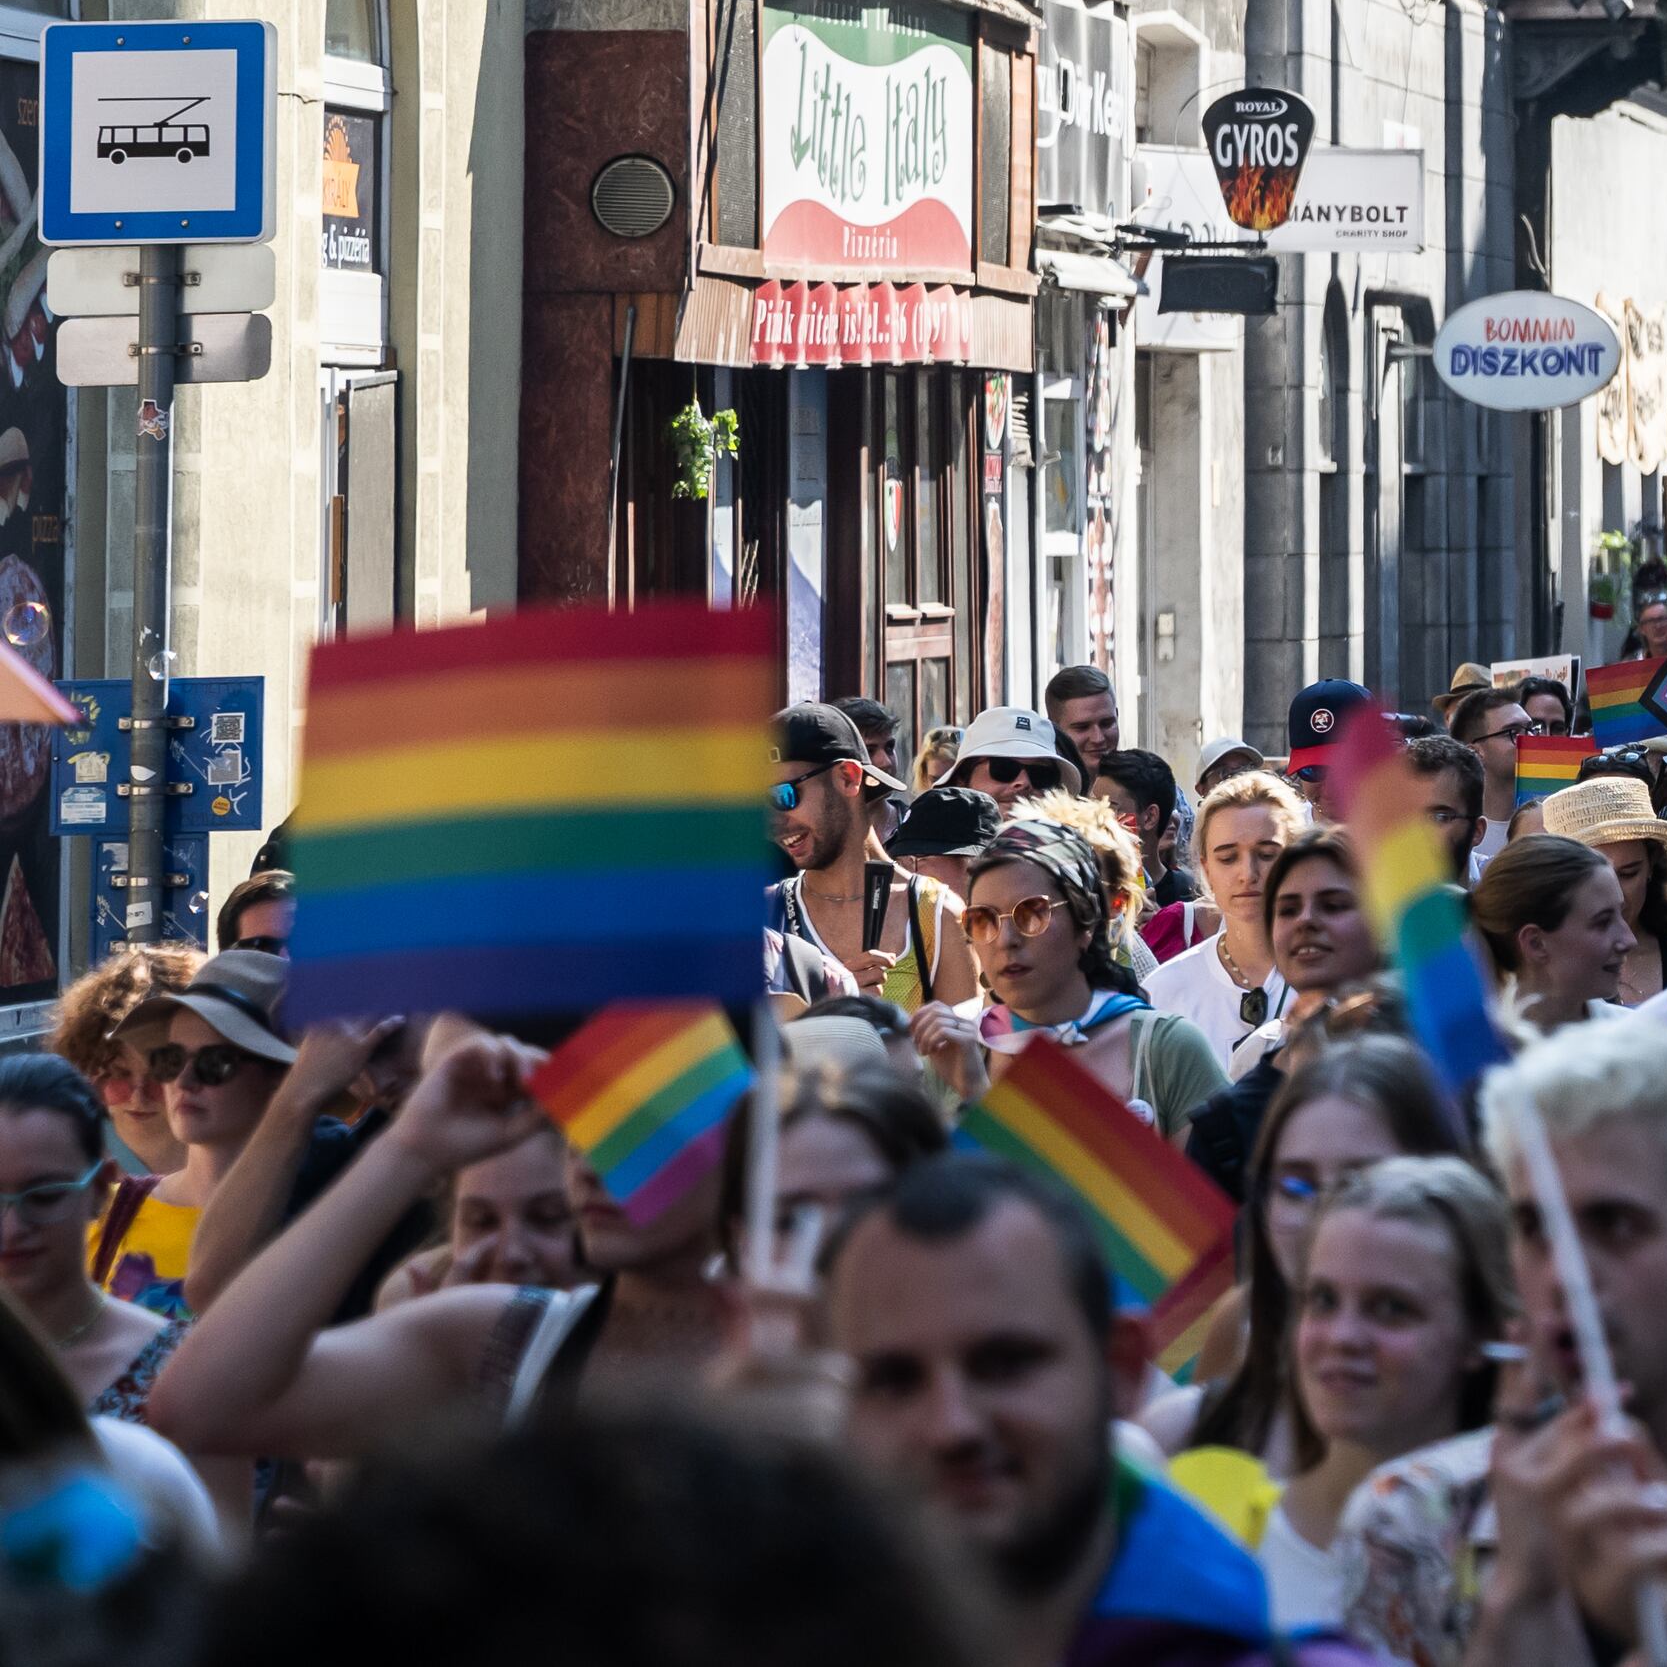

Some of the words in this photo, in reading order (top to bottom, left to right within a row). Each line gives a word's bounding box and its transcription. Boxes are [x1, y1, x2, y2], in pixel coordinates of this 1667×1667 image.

[1235, 101, 1280, 113] ROYAL
[790, 42, 866, 206] Little
[884, 65, 948, 206] Italy
[1215, 123, 1299, 168] GYROS
[1289, 201, 1408, 223] MÁNYBOLT
[338, 226, 370, 269] pizzéria
[843, 226, 897, 258] Pizzéria
[1336, 230, 1379, 238] CHARITY
[1382, 230, 1408, 238] SHOP
[1451, 342, 1606, 377] DISZKONT
